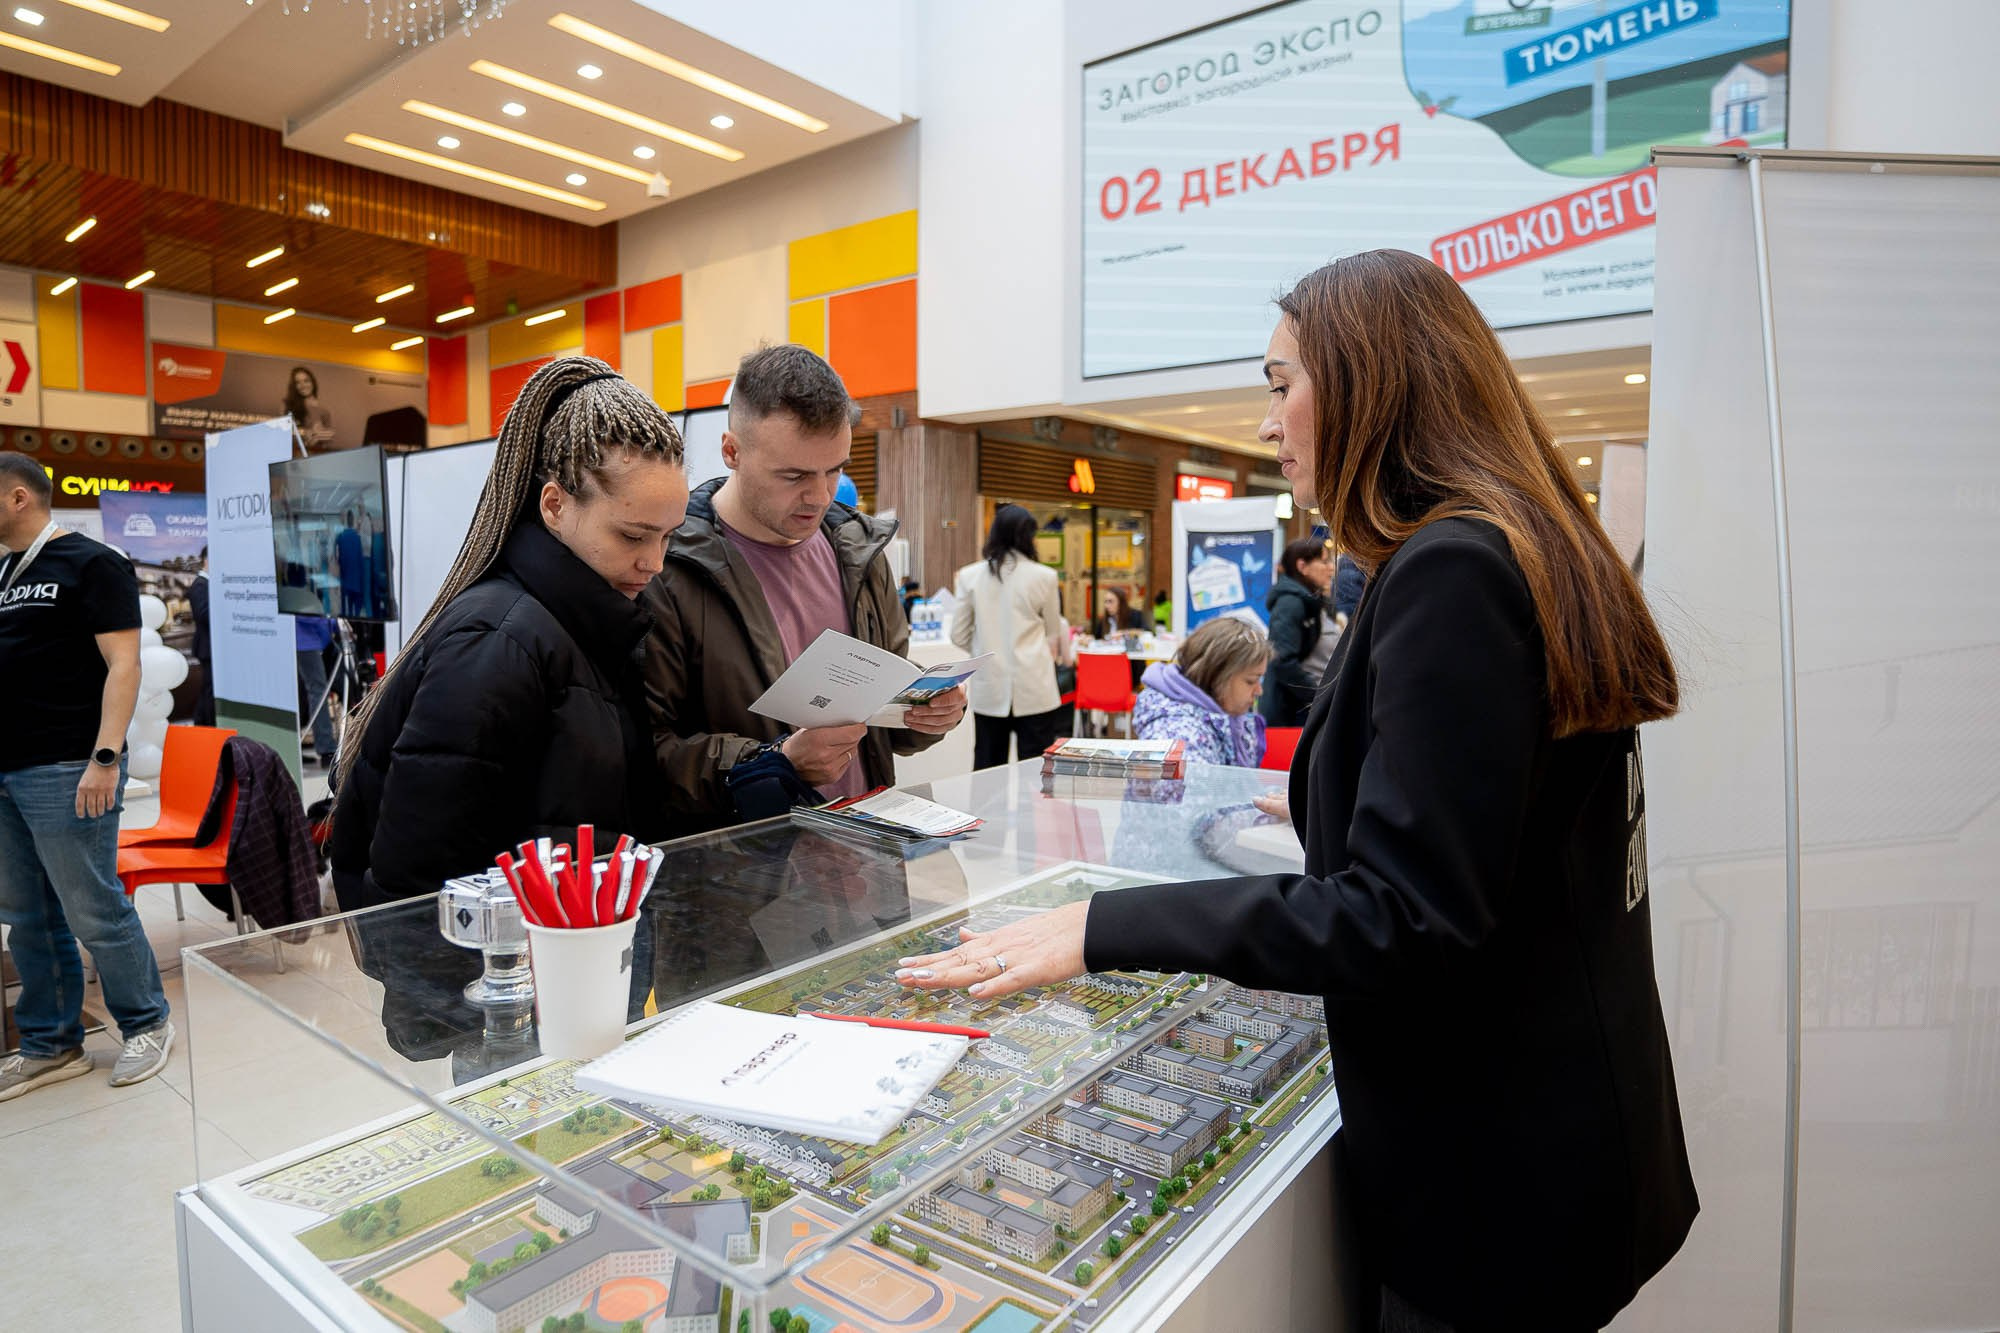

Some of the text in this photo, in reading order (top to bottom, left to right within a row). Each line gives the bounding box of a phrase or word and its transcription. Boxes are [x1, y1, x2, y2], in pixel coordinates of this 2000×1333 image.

[1098, 10, 1382, 111] ЗАГОРОД ЭКСПО
[1518, 0, 1700, 74] ТЮМЕНЬ
[1121, 94, 1190, 123] выставка
[1195, 65, 1292, 106] загородной
[1100, 123, 1400, 221] 02 ДЕКАБРЯ
[1435, 174, 1657, 277] ТОЛЬКО СЕГО
